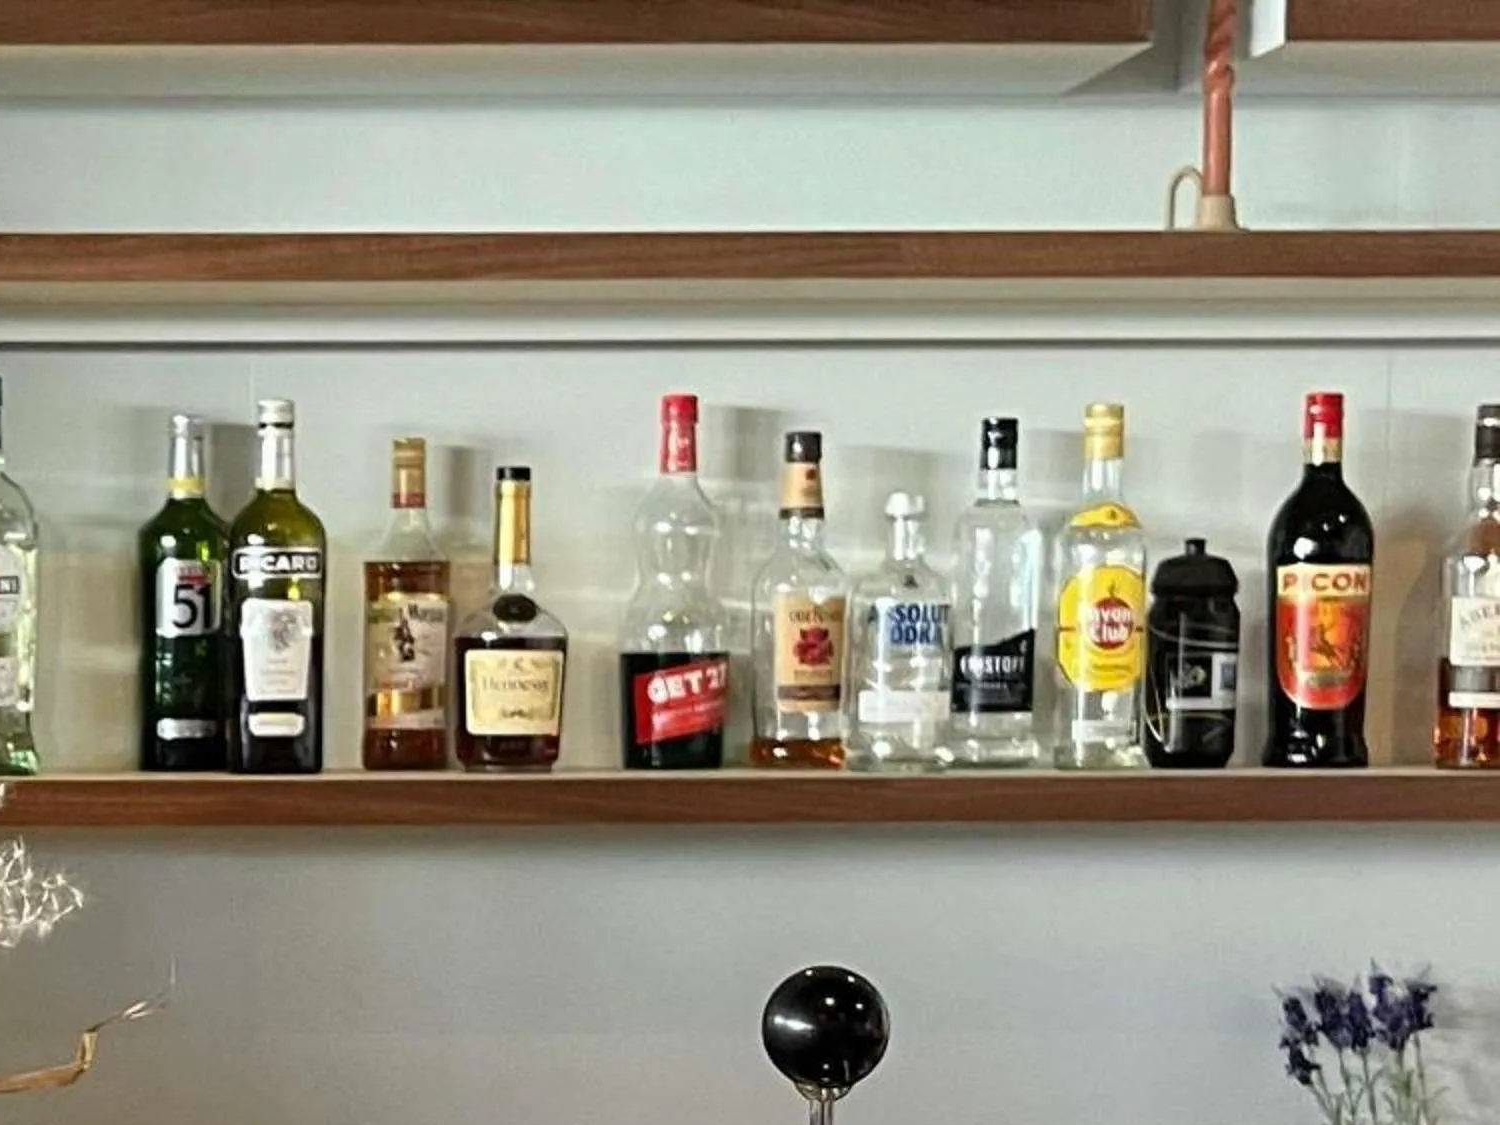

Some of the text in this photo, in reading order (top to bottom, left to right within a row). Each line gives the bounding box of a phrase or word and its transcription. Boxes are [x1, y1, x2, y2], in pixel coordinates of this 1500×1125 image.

[1282, 572, 1368, 591] PCON
[172, 584, 212, 629] 51
[647, 668, 703, 704] GET
